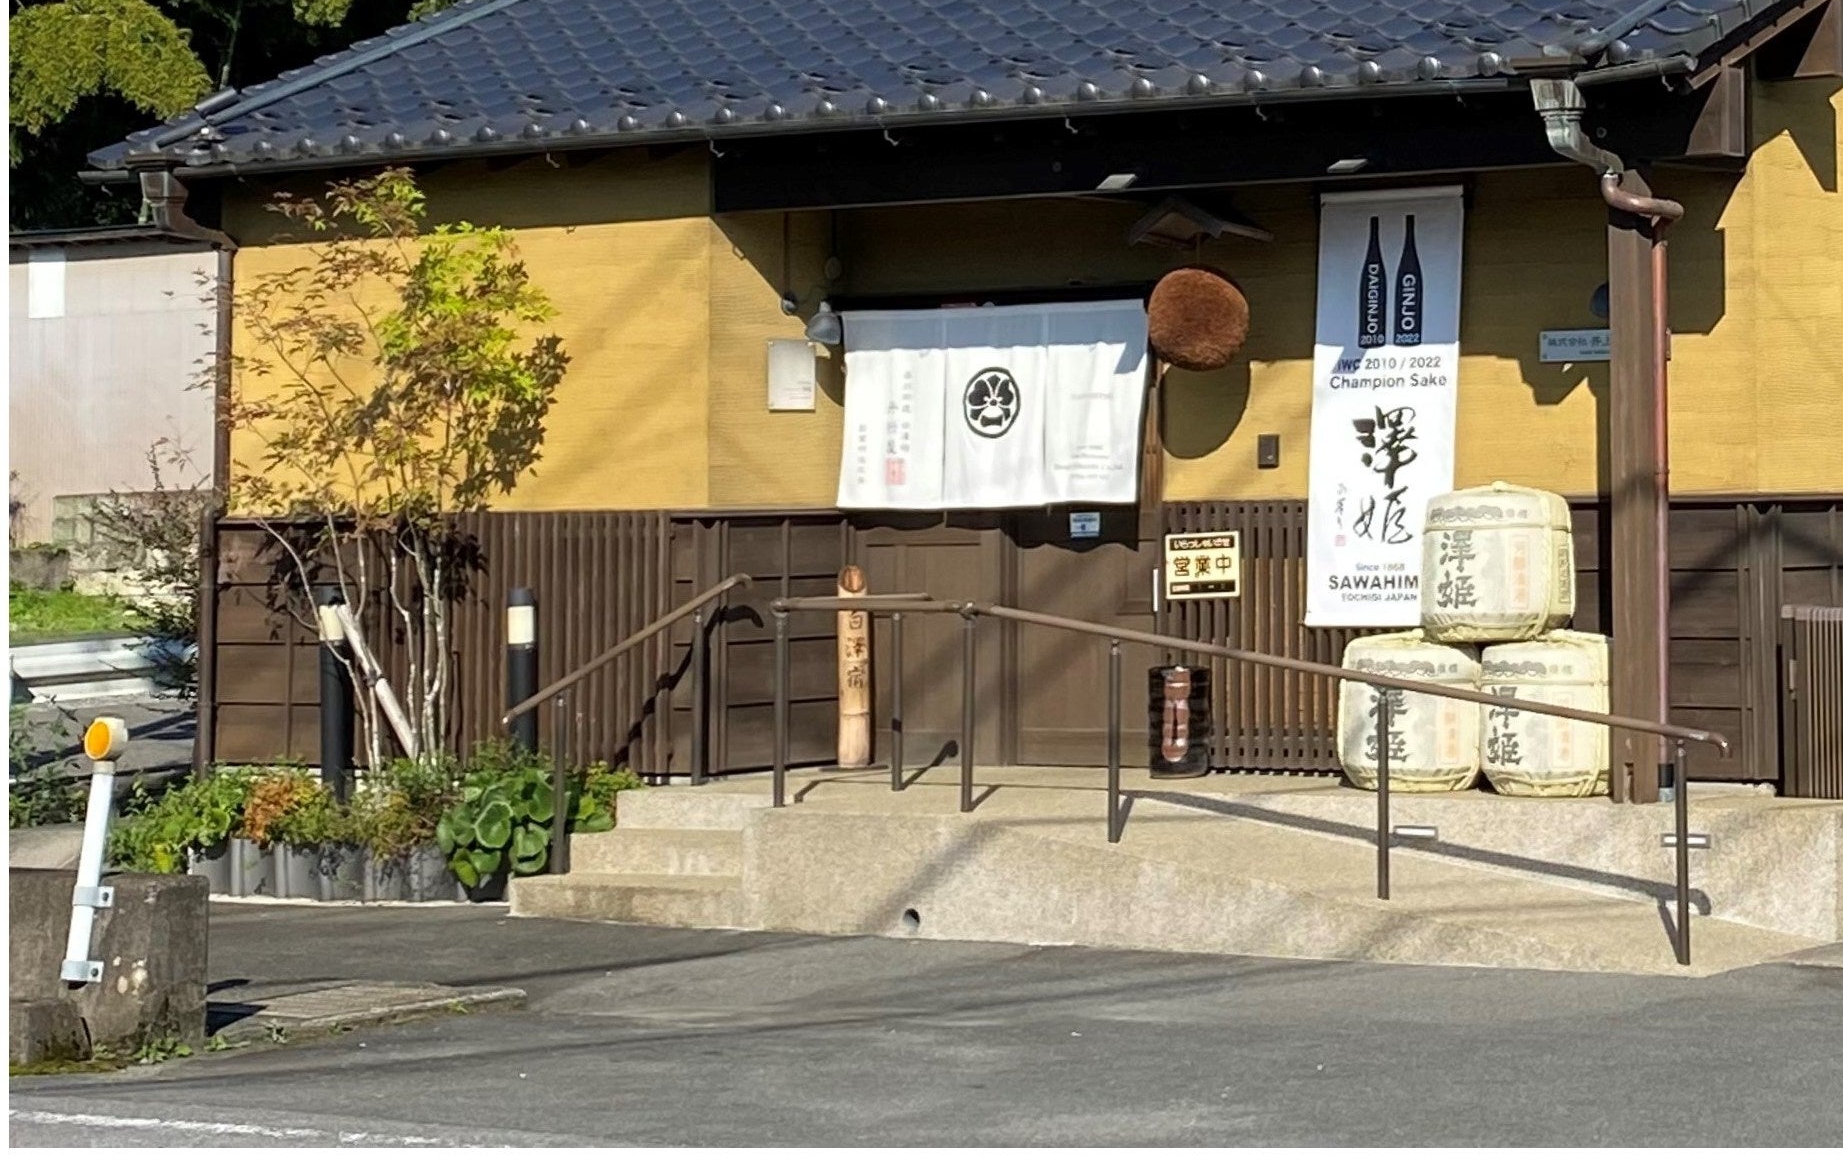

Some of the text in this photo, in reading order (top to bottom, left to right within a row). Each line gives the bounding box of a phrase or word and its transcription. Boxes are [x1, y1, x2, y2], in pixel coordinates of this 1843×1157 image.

[1366, 263, 1381, 334] DAIGINJO
[1400, 273, 1417, 331] GINJO
[1359, 333, 1386, 345] 2010
[1394, 331, 1420, 344] 2022
[1337, 357, 1361, 371] IWC
[1364, 357, 1397, 371] 2010
[1409, 355, 1442, 369] 2022
[1329, 372, 1447, 391] Champion Sake
[1173, 554, 1233, 578] 営業中
[1327, 574, 1420, 591] SAWAHIM
[1384, 591, 1419, 602] JAPAN
